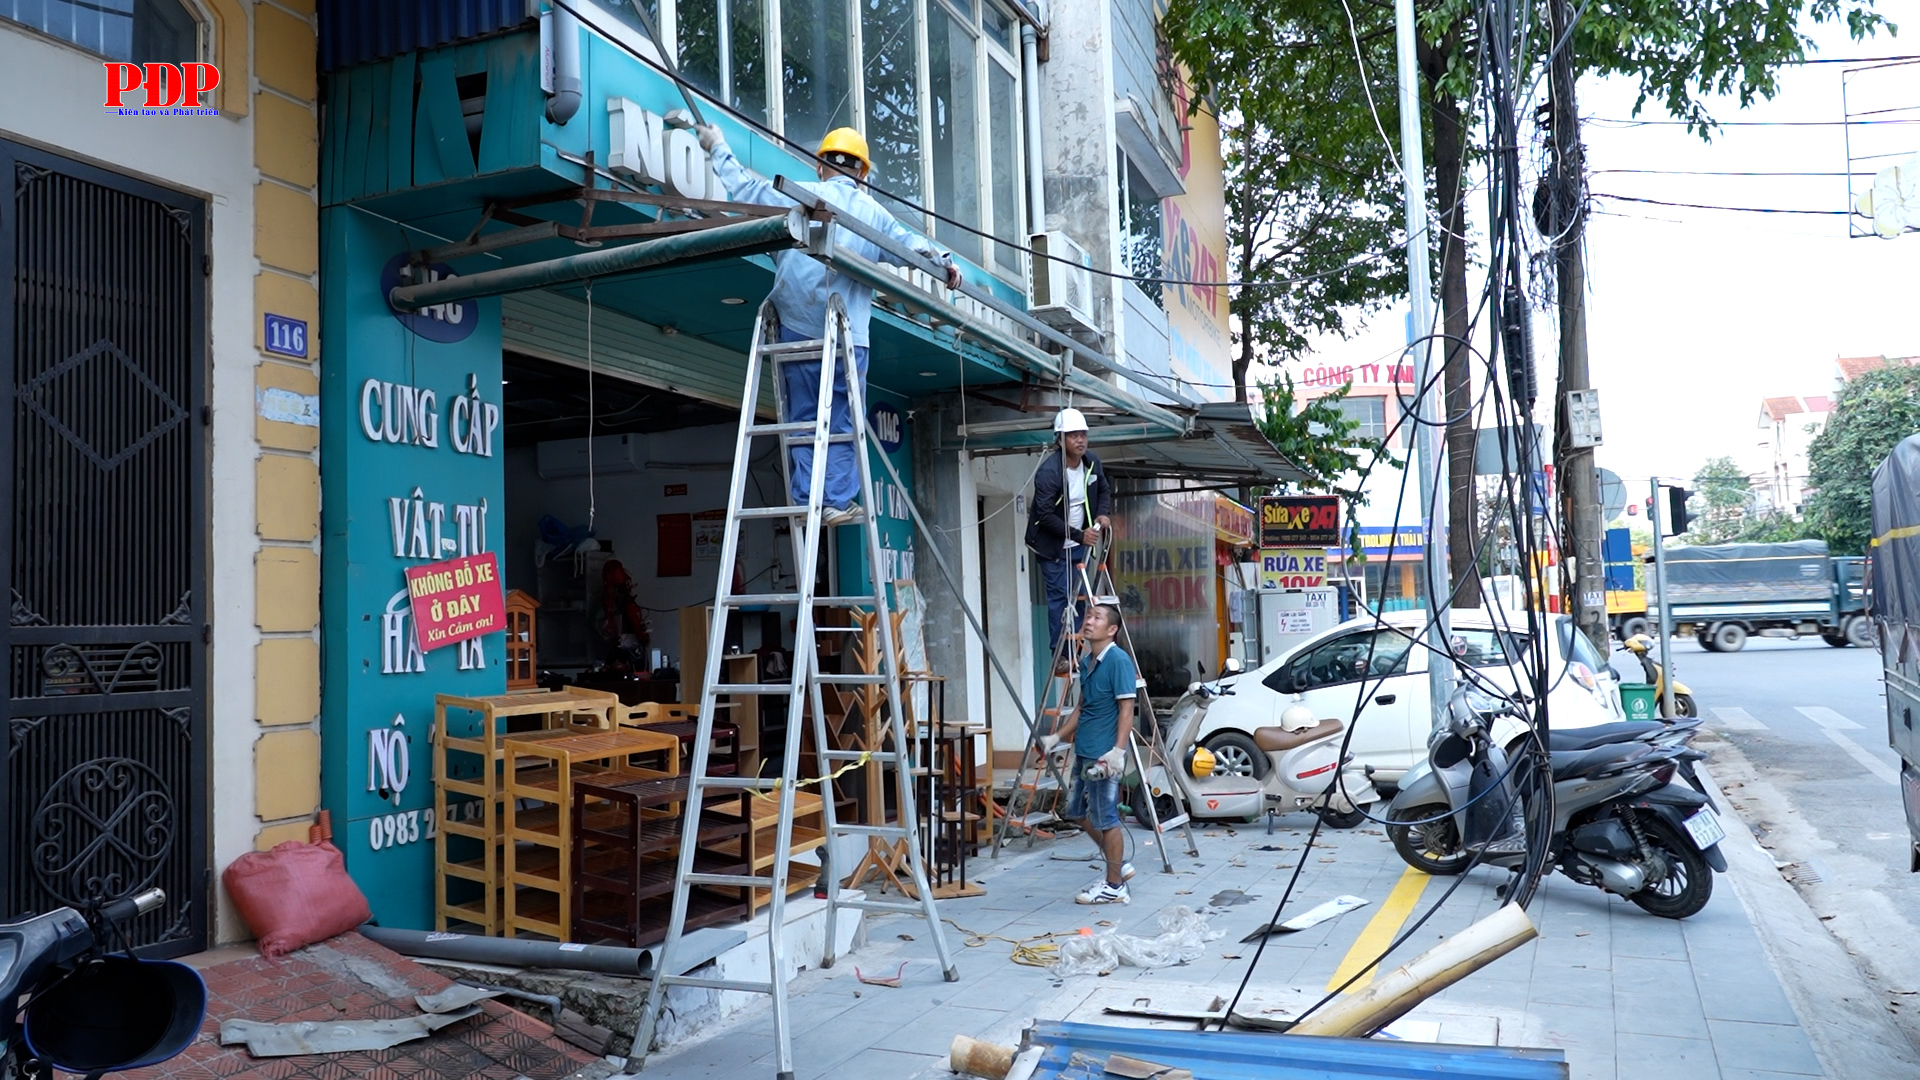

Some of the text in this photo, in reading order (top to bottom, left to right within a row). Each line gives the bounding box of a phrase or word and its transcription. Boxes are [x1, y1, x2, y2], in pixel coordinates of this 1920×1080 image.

[271, 321, 304, 351] 116
[1303, 362, 1354, 387] CÔNG
[1359, 364, 1379, 383] TY
[360, 373, 499, 457] CUNG CẤP
[875, 410, 900, 444] 114C
[454, 497, 488, 558] TƯ
[1119, 542, 1208, 574] RỬA XE
[1264, 552, 1324, 572] RỬA XE
[411, 561, 494, 598] KHÔNG ĐỖ XE
[1143, 576, 1209, 612] 10K
[430, 594, 480, 622] Ở ĐÂY
[1305, 593, 1327, 601] TAXI
[428, 628, 446, 642] Xin
[448, 622, 474, 637] Cảm
[370, 810, 419, 851] 0983
[424, 804, 458, 839] 27
